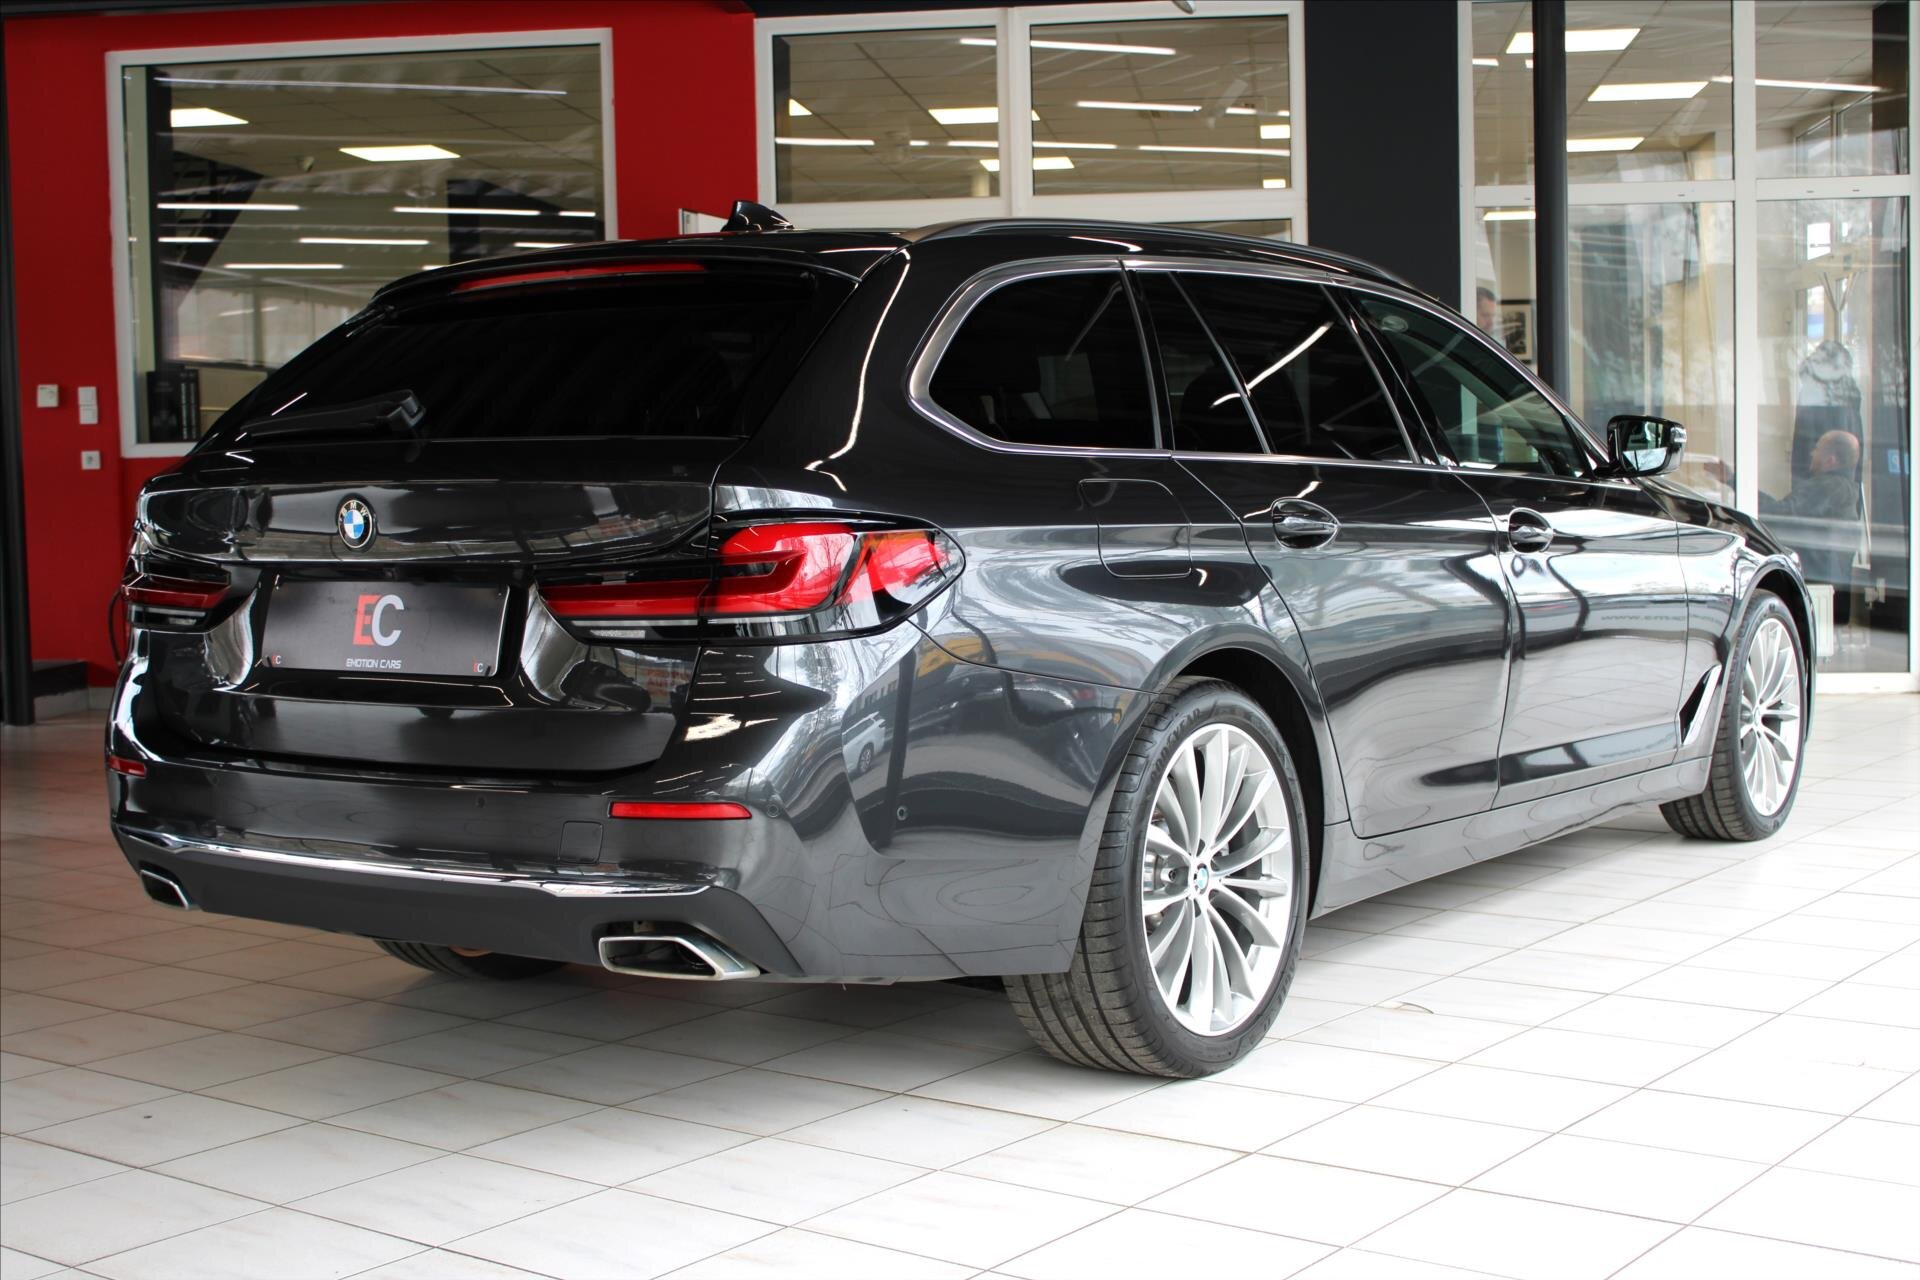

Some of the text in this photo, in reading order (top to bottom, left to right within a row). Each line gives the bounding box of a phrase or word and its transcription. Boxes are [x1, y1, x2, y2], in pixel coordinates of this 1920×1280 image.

[340, 501, 368, 517] BMW
[352, 594, 405, 646] EC
[346, 658, 402, 669] EMOTION CARS
